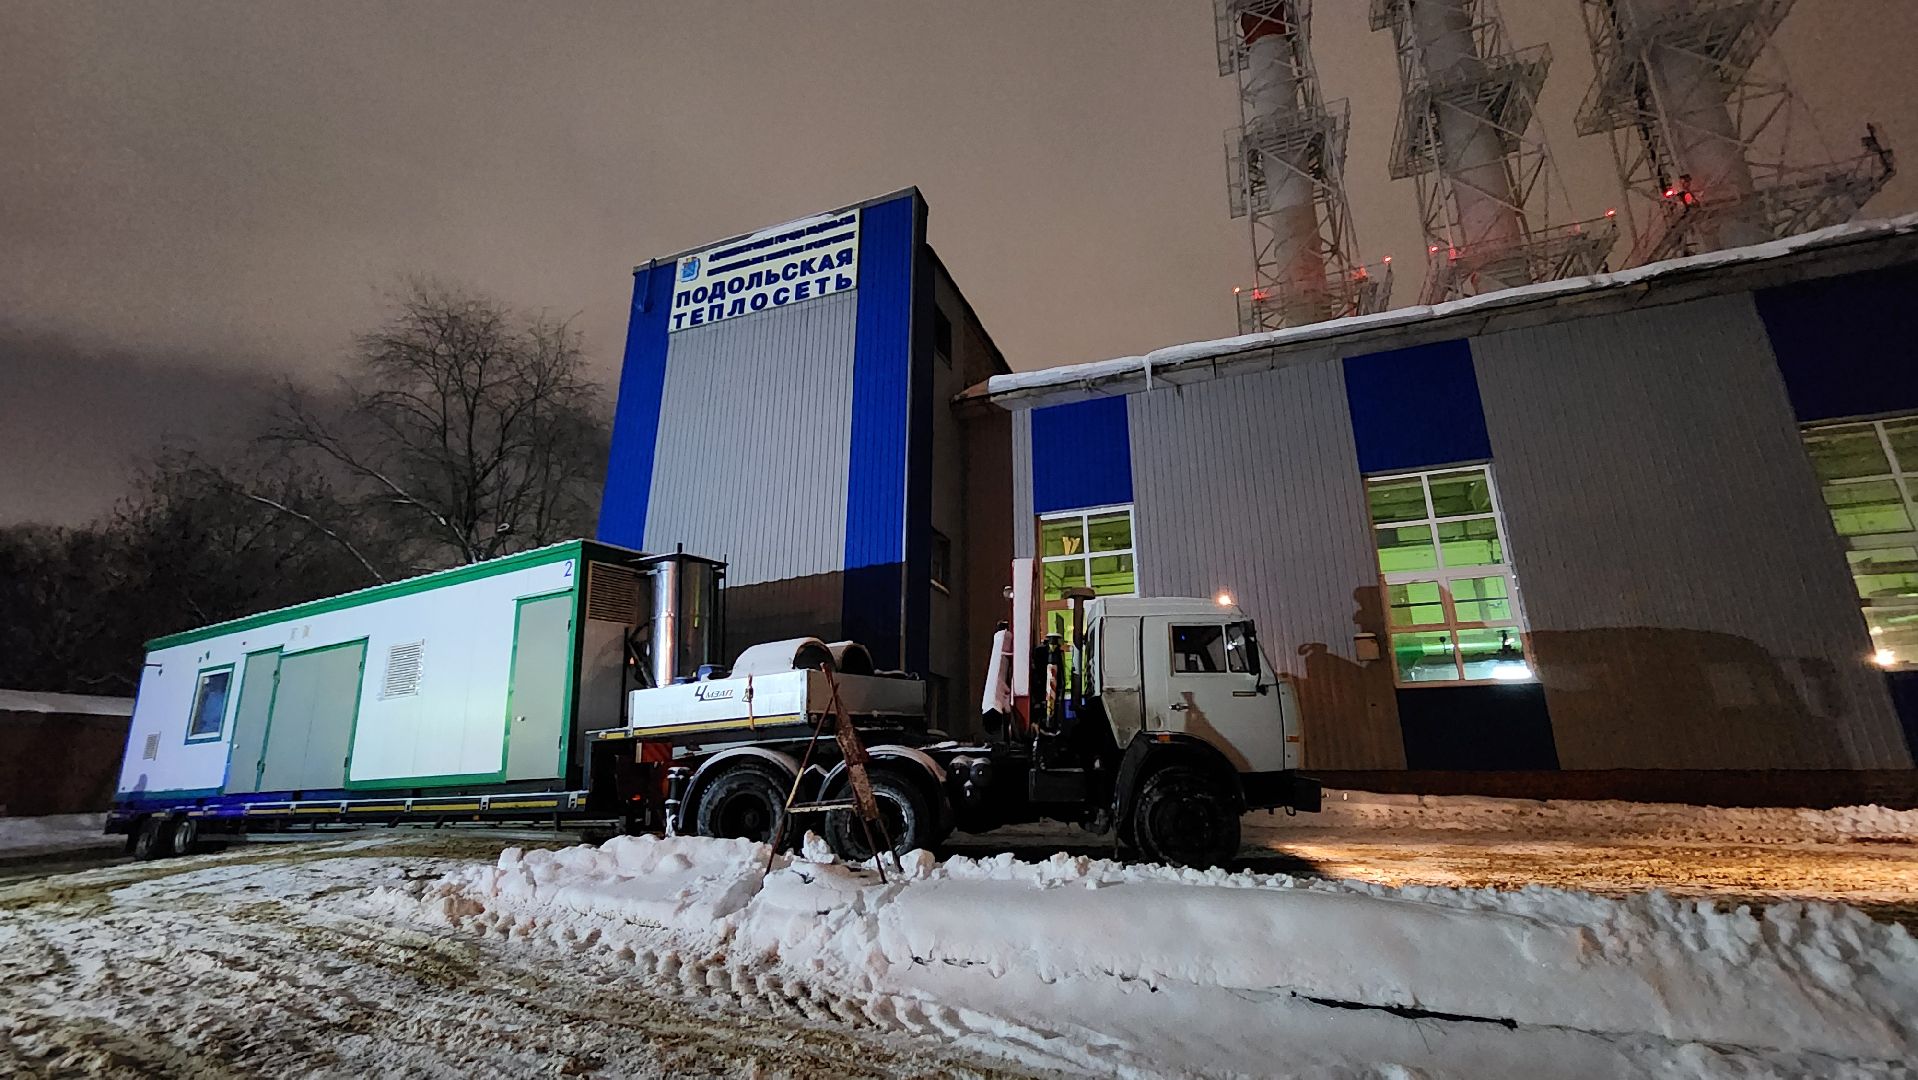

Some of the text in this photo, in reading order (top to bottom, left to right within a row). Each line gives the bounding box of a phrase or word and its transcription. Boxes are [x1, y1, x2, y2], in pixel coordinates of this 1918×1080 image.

[674, 274, 853, 329] ТЕПЛОСЕТЬ
[676, 248, 853, 308] ПОДОЛЬСКАЯ
[564, 561, 573, 577] 2
